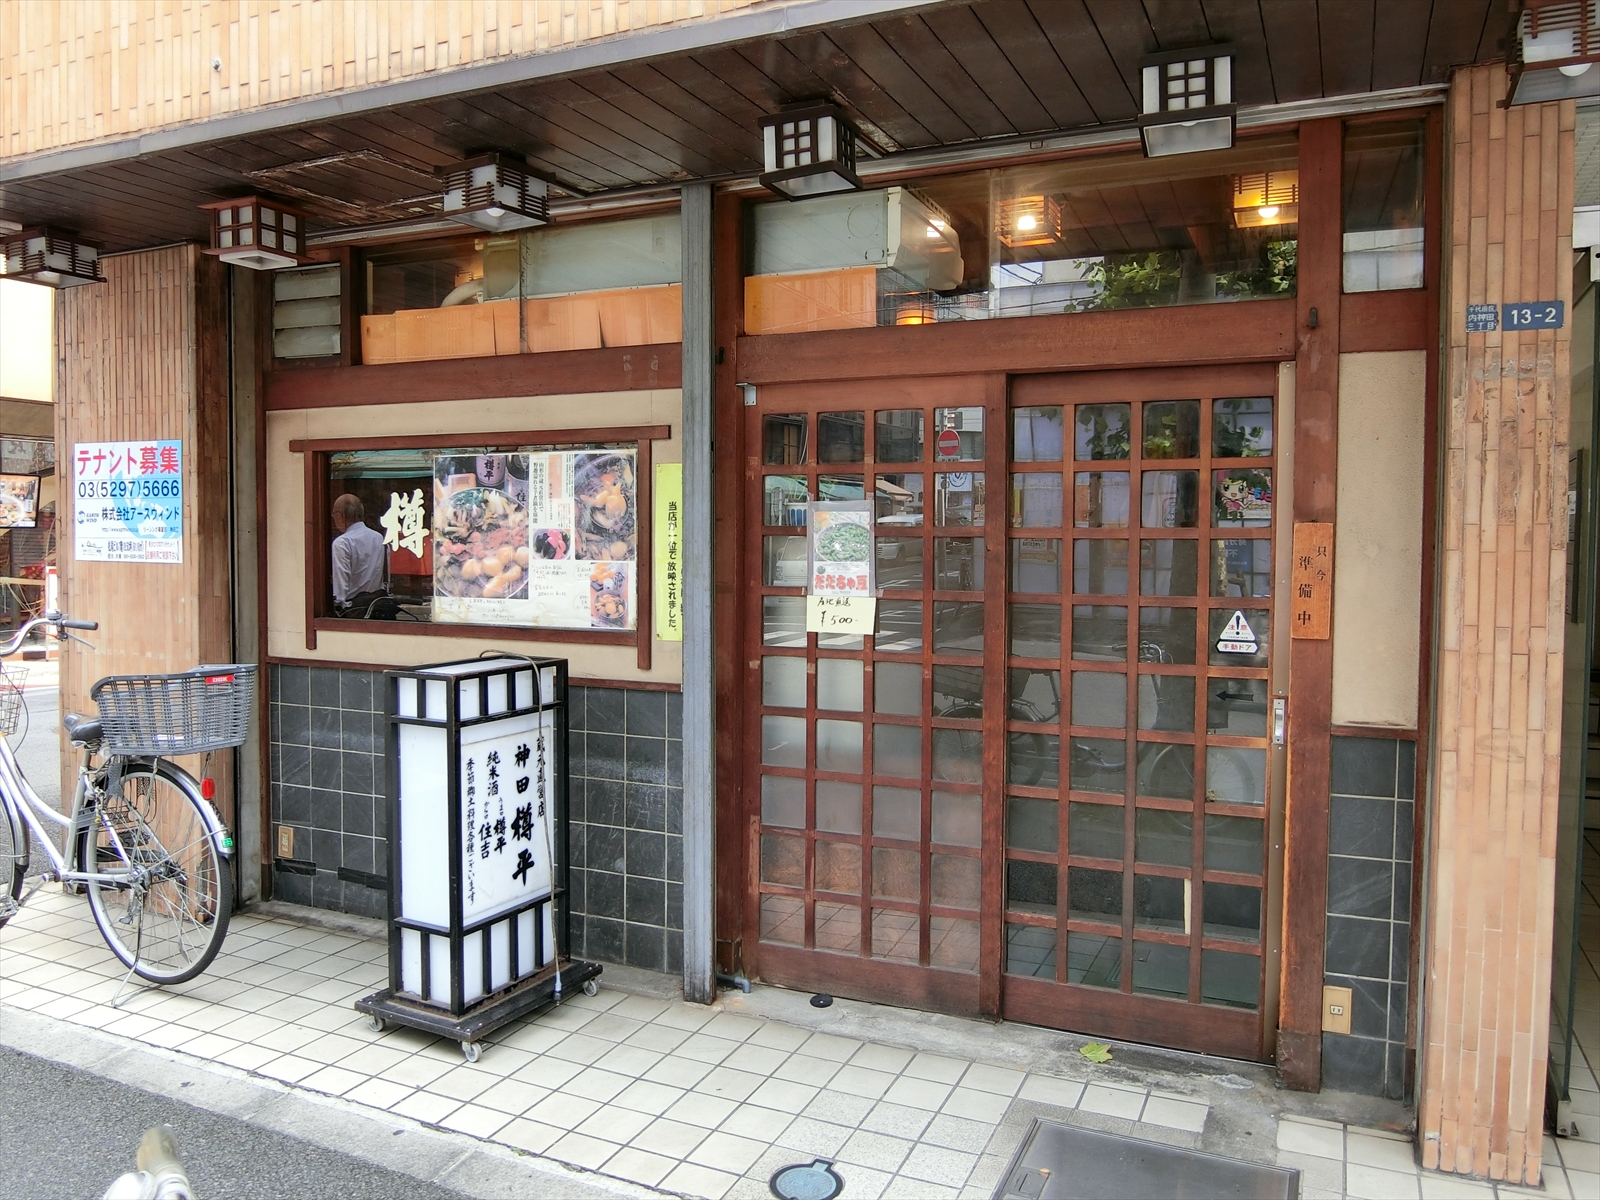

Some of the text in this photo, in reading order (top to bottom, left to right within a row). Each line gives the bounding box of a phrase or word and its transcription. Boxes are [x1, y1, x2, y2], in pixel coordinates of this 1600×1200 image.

[1468, 313, 1494, 322] 内神田
[1468, 322, 1494, 330] 三丁目
[1511, 307, 1556, 325] 13-2
[77, 446, 179, 476] テナント募集
[79, 480, 179, 498] 03(5297)5666
[102, 506, 179, 521] 株式会社アースウィンド
[381, 489, 430, 558] 樽
[667, 501, 677, 631] 当店が一位で放映されました。
[1316, 546, 1327, 581] 只今
[1297, 556, 1313, 626] 準備中
[1223, 643, 1252, 651] 手動ドア
[486, 750, 501, 797] 純米酒
[478, 822, 493, 860] 住吉
[493, 816, 507, 855] 樽平
